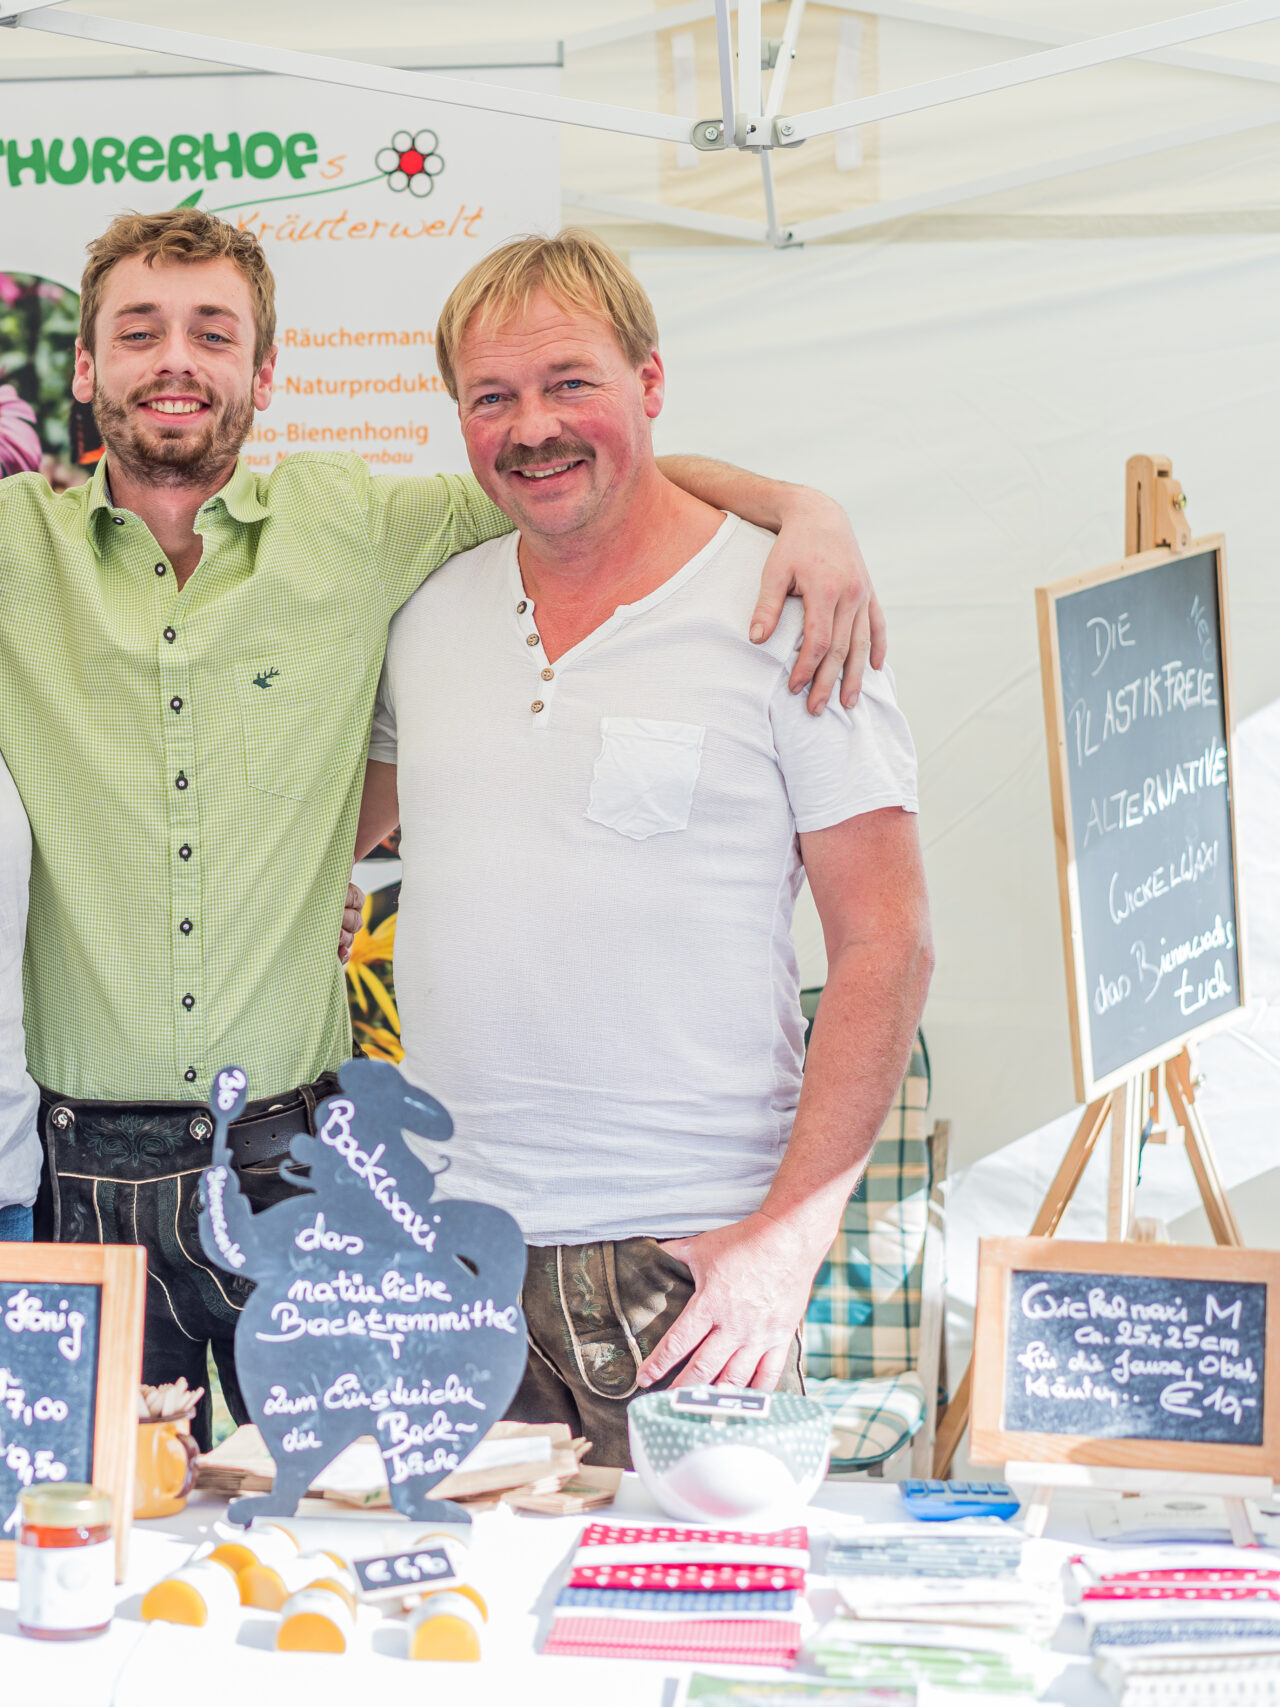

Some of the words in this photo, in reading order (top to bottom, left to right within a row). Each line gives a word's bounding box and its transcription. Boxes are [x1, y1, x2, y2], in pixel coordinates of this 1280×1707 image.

[1086, 612, 1136, 677] DIE
[1083, 735, 1229, 849] ALTERNATIVE
[295, 1212, 365, 1256] das
[1204, 1294, 1242, 1330] M
